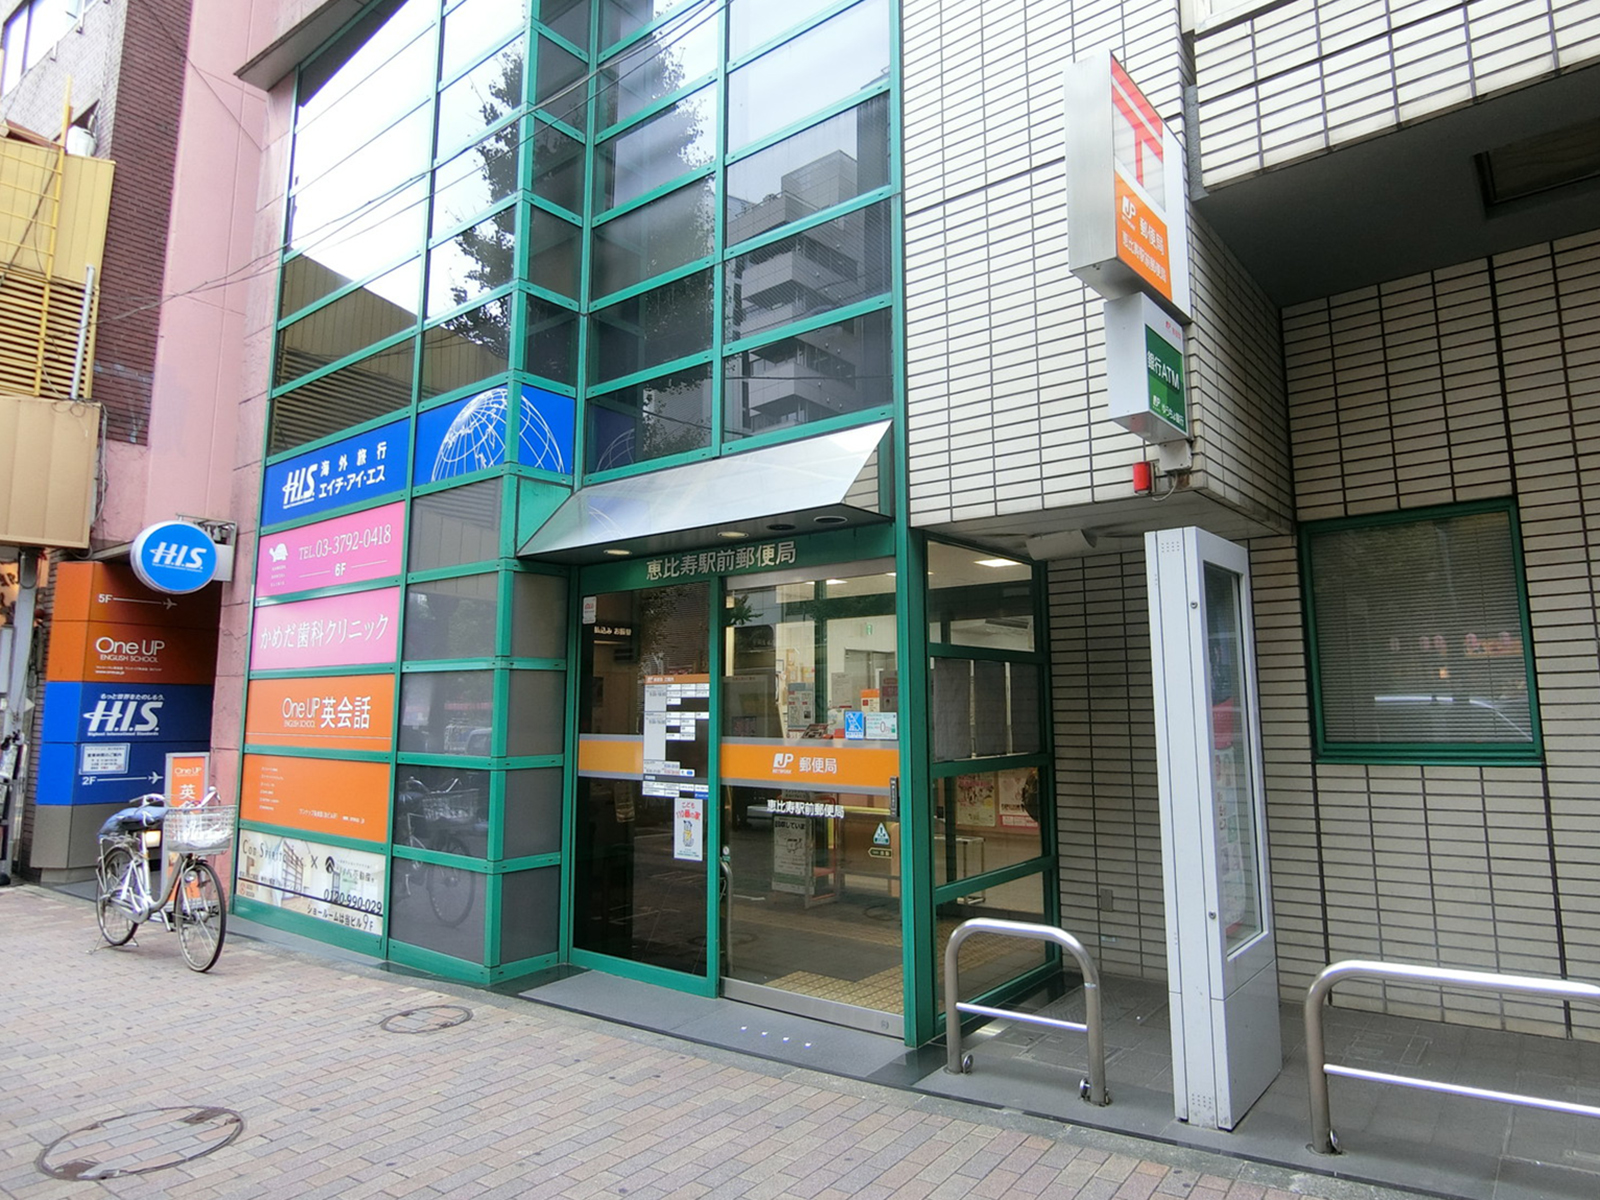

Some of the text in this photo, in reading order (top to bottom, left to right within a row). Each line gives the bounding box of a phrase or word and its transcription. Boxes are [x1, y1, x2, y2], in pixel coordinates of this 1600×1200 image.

[1139, 216, 1165, 256] 郵便局
[1147, 350, 1180, 390] 銀行ATM
[320, 441, 387, 477] 海外旅行
[334, 562, 347, 577] 6F
[645, 540, 797, 582] 恵比寿駅前郵便局
[98, 593, 113, 604] 5F
[260, 614, 389, 649] かめだ歯科クリニック
[95, 636, 165, 656] One UP
[100, 653, 158, 663] ENGLISH SCHOOL
[282, 696, 372, 729] One UP 英会話
[799, 757, 837, 774] 郵便局
[82, 776, 97, 785] 2F
[766, 799, 845, 819] 恵比寿駅前郵便局
[323, 888, 383, 915] 0120-990-029
